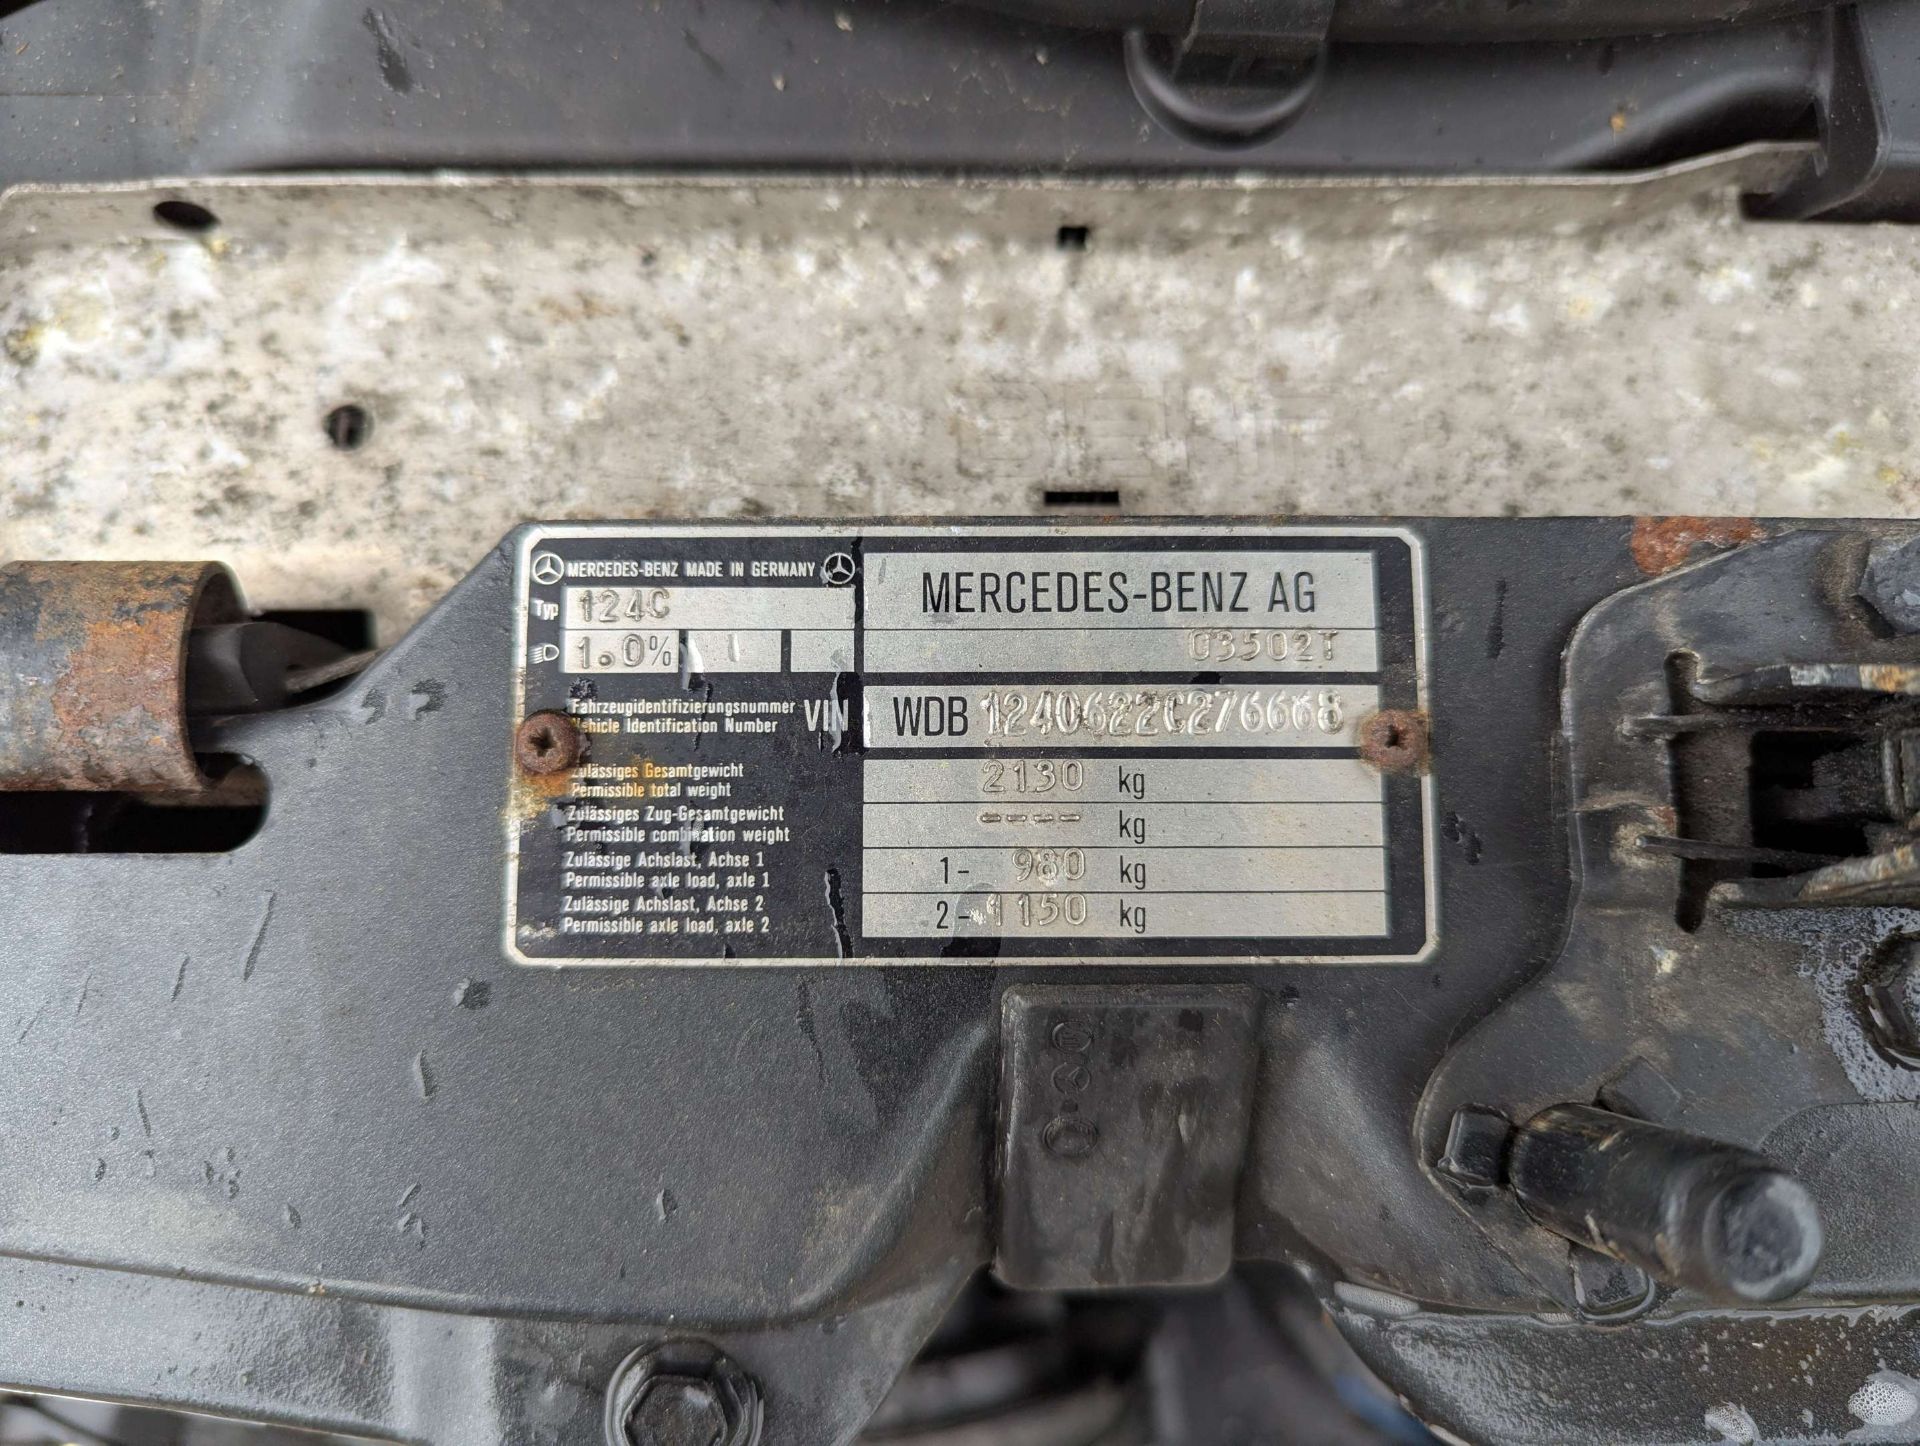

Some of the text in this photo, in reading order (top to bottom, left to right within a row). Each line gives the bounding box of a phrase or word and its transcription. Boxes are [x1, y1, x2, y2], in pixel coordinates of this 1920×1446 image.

[567, 561, 816, 578] MERCEDES-BENZ MADE IN GERMANY
[922, 571, 1316, 613] MERCEDES-BENZ AG
[534, 599, 559, 621] Typ
[580, 588, 671, 622] 124C
[570, 699, 796, 716] Fahrzeugidentifizierungsnummer
[803, 699, 850, 732] VIN
[893, 696, 968, 737] WDB
[627, 718, 719, 734] Identification
[725, 718, 778, 734] Number
[571, 762, 744, 781] Zulässiges Gesamtgewicht
[982, 760, 1145, 799] 2130 kg
[570, 782, 731, 800] Permissible total weight
[567, 805, 785, 824] Zulässiges Zug-Gesamtgewicht
[1119, 810, 1146, 844] kg
[566, 827, 790, 847] Permissible combination weight
[565, 851, 764, 870] Zulässige Achslast, Achse 1
[1012, 847, 1086, 882] 980
[1119, 855, 1146, 890] kg
[565, 872, 770, 890] Permissible axle load, axle 1
[564, 895, 764, 914] Zulässige Achslast, Achse 2
[564, 916, 770, 934] Permissible axle load, axle 2
[1119, 898, 1146, 934] kg
